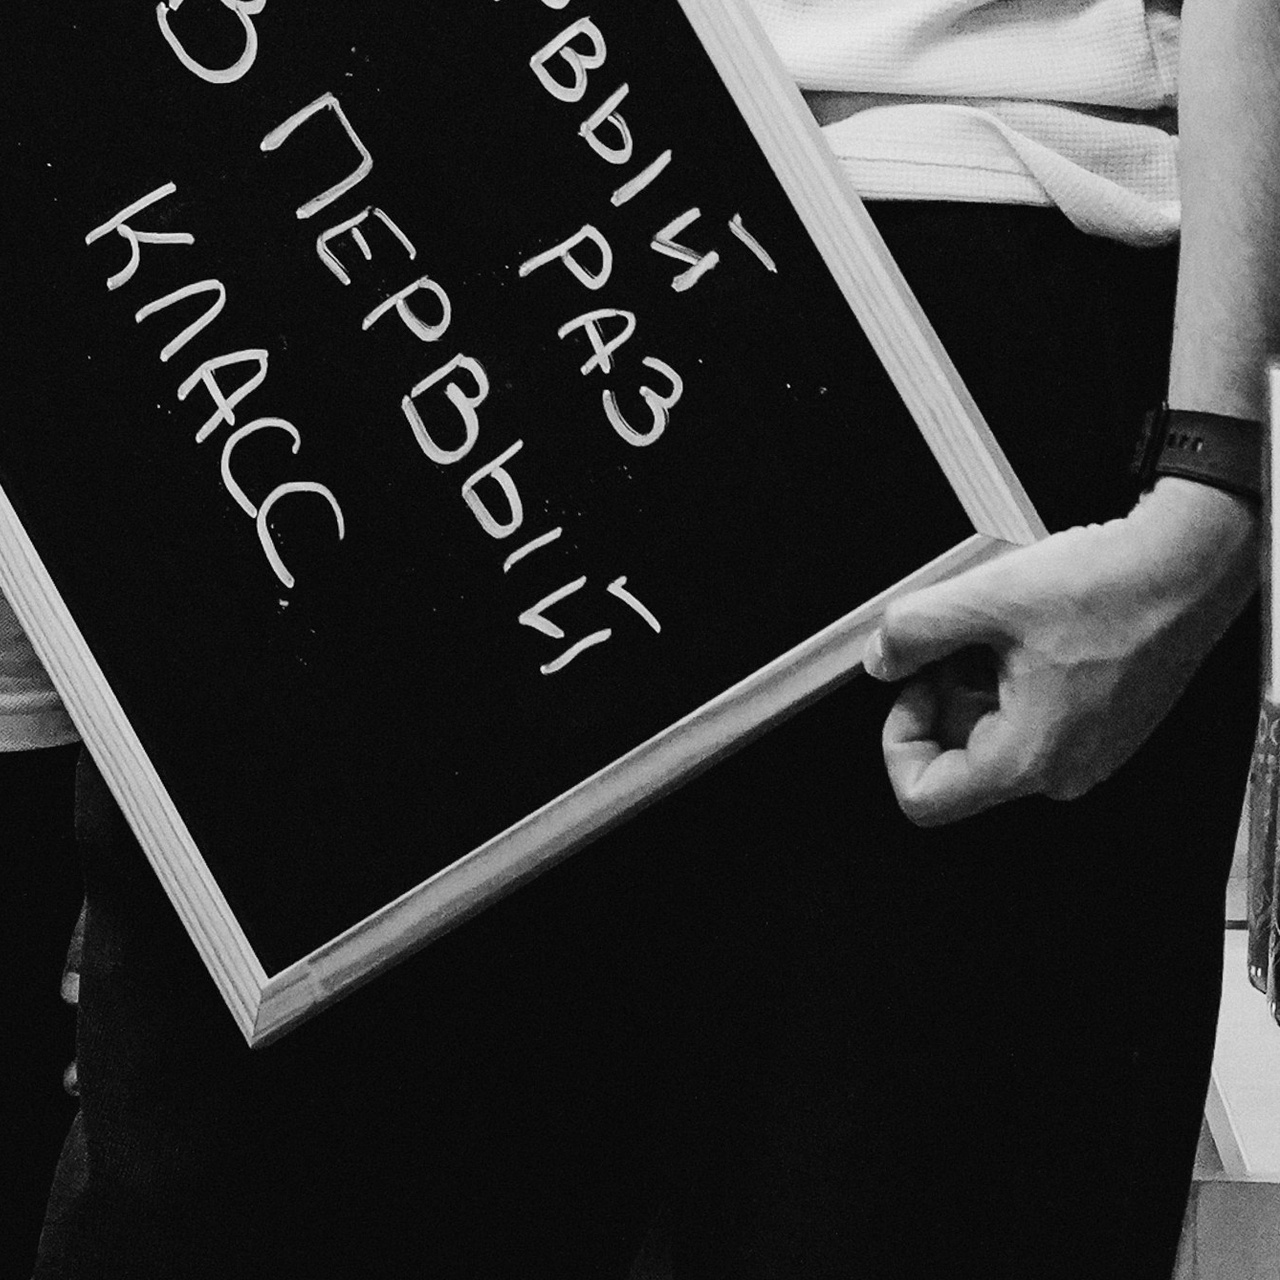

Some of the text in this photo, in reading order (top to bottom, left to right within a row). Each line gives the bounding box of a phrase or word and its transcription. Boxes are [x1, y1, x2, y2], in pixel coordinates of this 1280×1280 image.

[85, 182, 344, 588] КЛАСС
[260, 92, 661, 674] ПЕРВЫЙ
[519, 224, 683, 446] РАЗ
